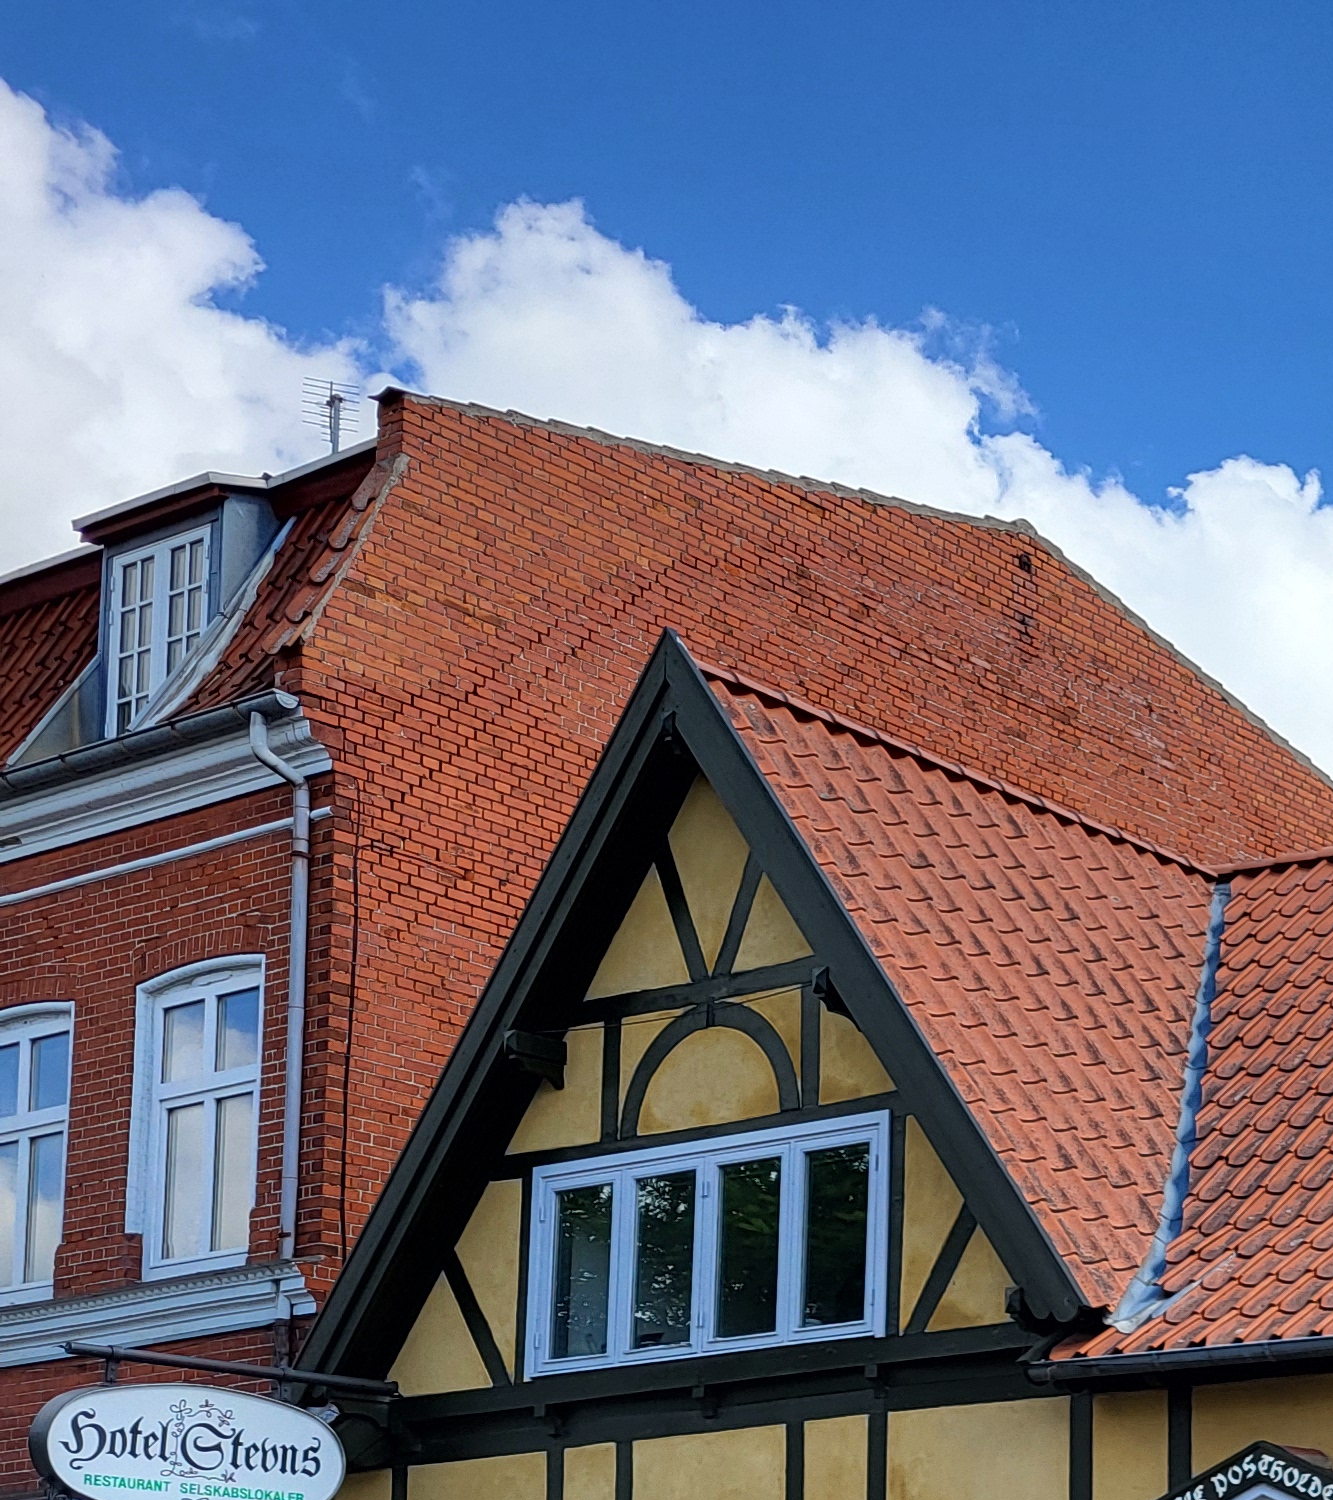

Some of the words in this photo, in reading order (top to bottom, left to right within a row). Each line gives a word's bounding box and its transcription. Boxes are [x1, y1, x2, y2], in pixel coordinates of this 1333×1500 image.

[58, 1407, 174, 1470] Hotel
[180, 1422, 322, 1478] Stevns
[84, 1473, 171, 1492] RESTAURANT
